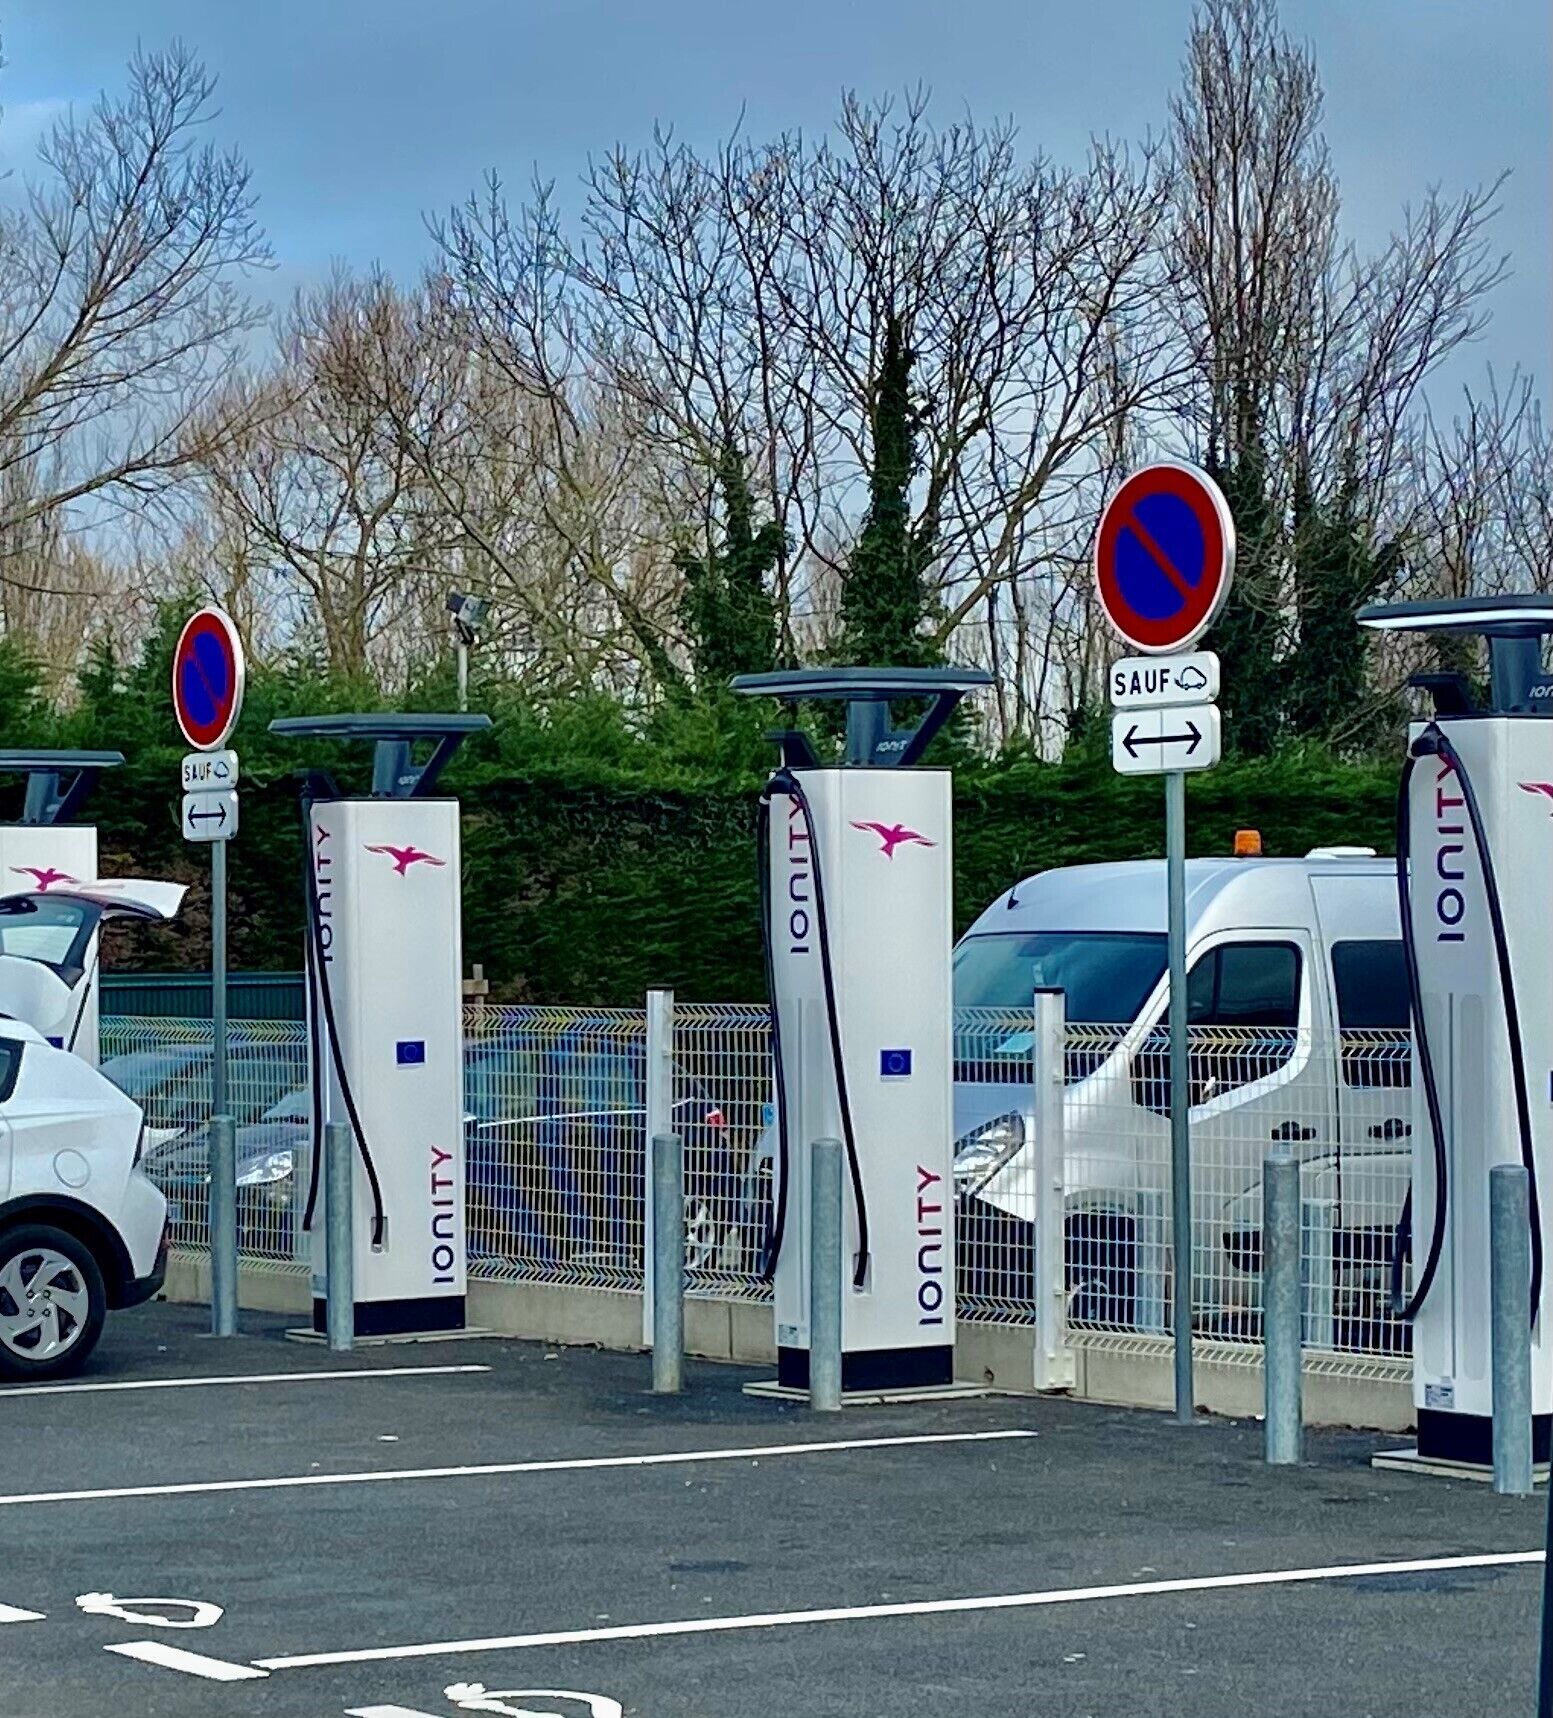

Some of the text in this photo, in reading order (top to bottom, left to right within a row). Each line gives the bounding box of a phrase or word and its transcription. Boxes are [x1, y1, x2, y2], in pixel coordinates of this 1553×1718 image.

[1115, 668, 1170, 696] SAUF
[184, 761, 211, 782] SAUF
[317, 824, 334, 962] IONITY
[789, 793, 809, 953] IONITY
[1437, 751, 1465, 942] IONITY
[431, 1145, 455, 1284] IONITY
[917, 1165, 944, 1325] IONITY
